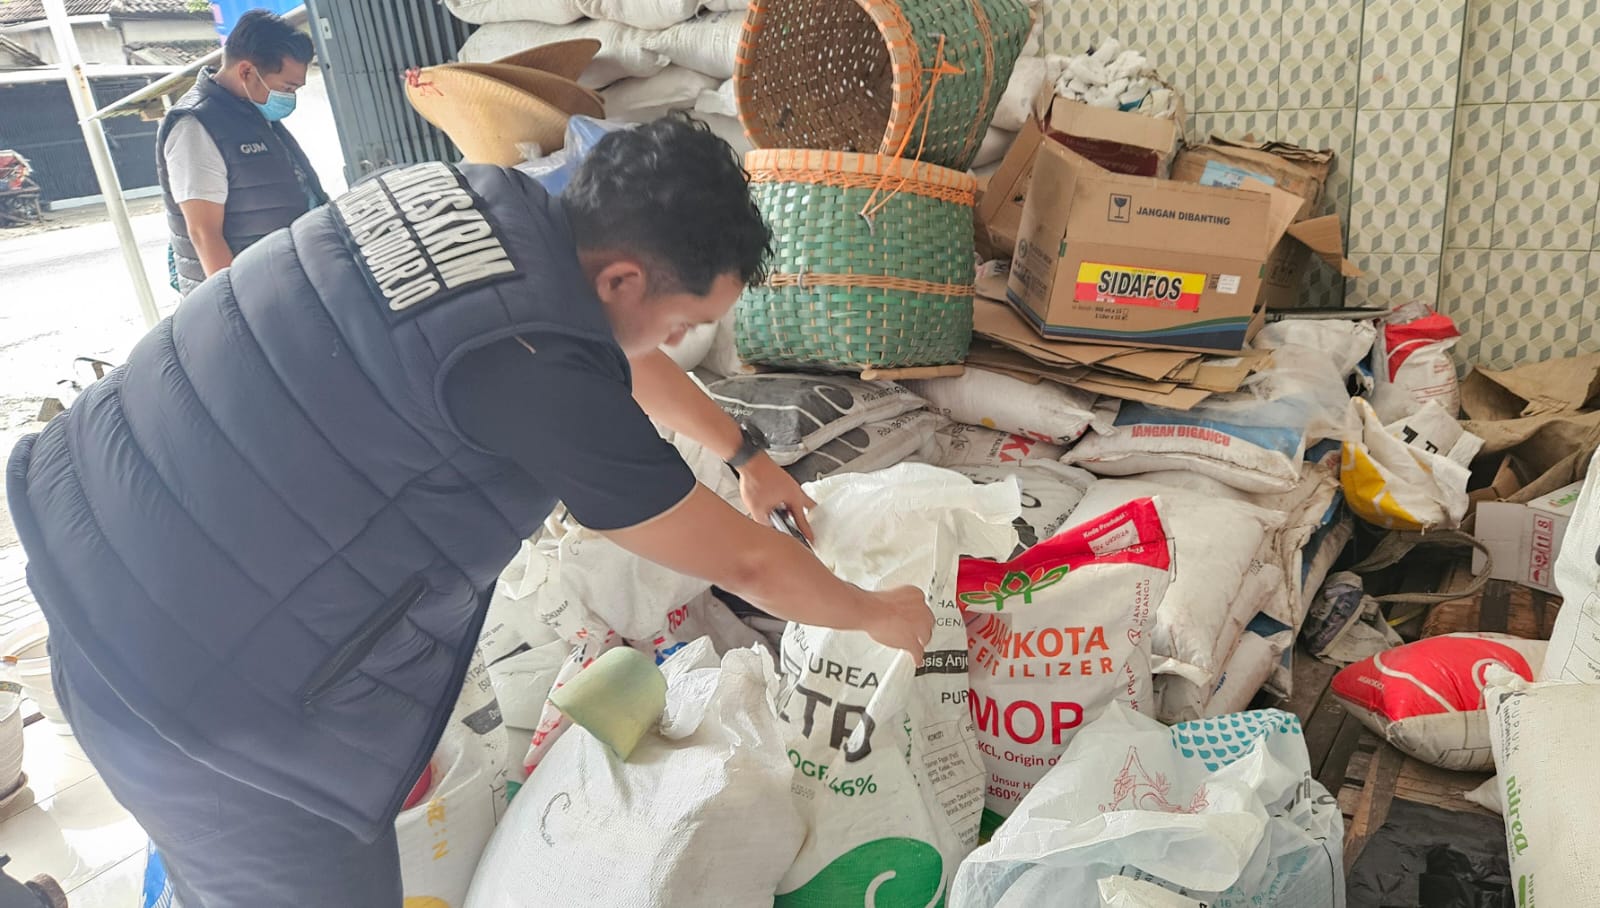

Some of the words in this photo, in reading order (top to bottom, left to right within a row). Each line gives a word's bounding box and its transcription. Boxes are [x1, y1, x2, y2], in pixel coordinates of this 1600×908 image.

[240, 142, 268, 154] GUM
[1136, 205, 1176, 221] JANGAN
[1177, 211, 1231, 226] DIBANTING
[355, 218, 441, 312] SIDOARJO
[1098, 270, 1183, 300] SIDAFOS
[1131, 425, 1174, 438] JANGAN
[1177, 426, 1231, 447] DIGANCU
[1133, 581, 1142, 623] JANGAN
[808, 652, 880, 689] UREA
[969, 688, 1084, 746] MOP
[1003, 750, 1045, 768] Origin
[829, 774, 877, 797] 46%
[991, 773, 1020, 789] Unsur
